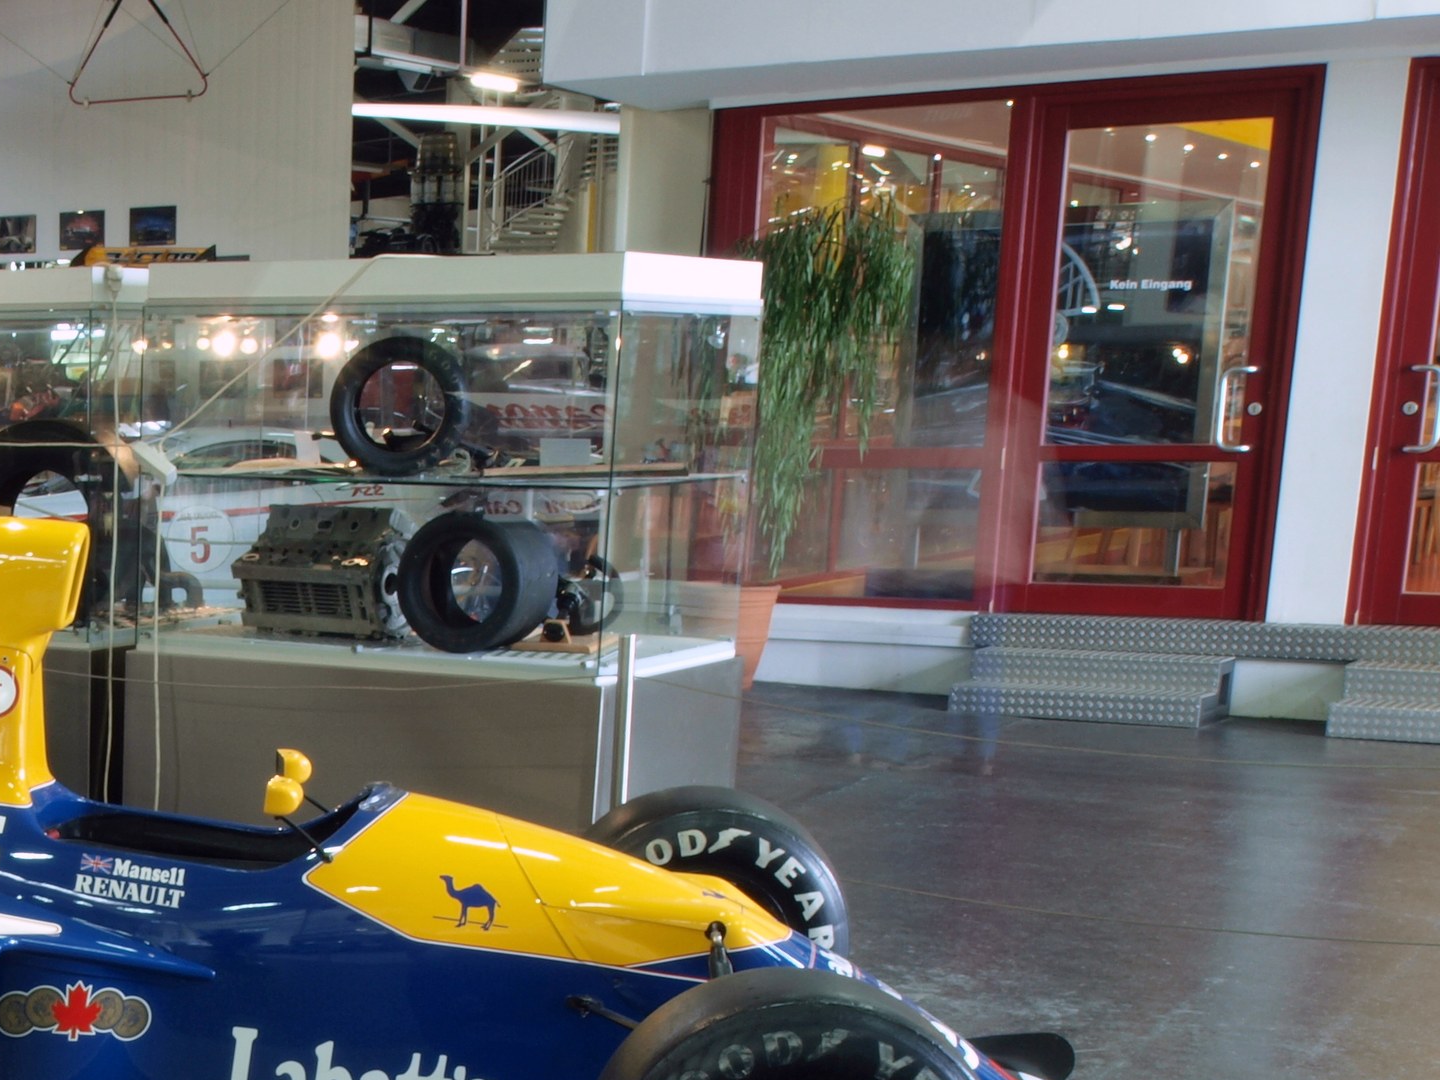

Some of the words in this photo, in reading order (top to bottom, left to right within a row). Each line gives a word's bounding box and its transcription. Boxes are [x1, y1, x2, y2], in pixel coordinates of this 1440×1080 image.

[1110, 279, 1138, 290] Kein
[1141, 279, 1192, 291] Eingang
[190, 526, 211, 564] 5
[112, 856, 186, 887] Mansell
[75, 873, 186, 909] RENAULT
